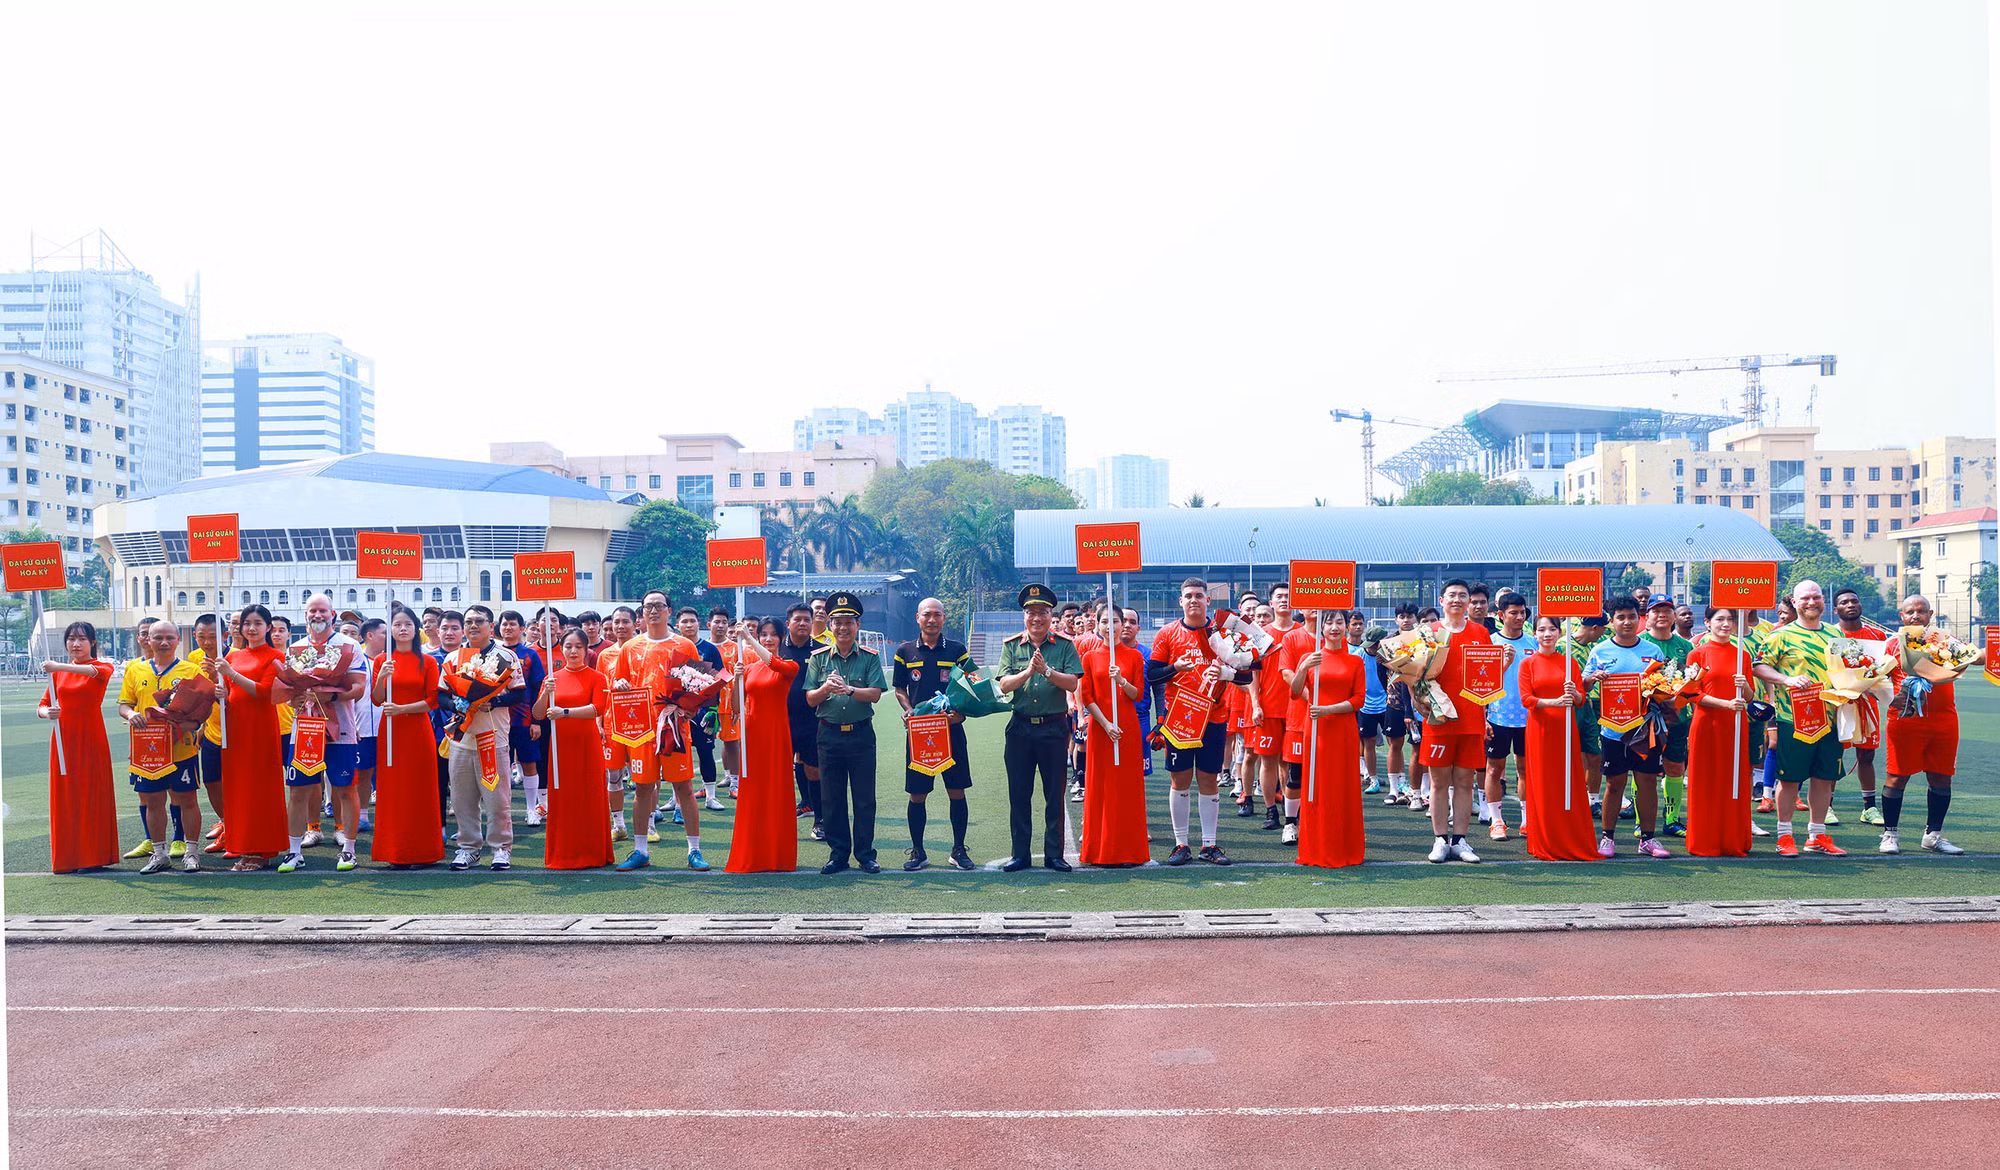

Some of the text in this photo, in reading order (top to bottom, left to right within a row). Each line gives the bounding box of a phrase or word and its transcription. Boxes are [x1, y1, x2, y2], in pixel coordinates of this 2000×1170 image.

[193, 528, 234, 540] ĐẠI SỨ QUÁN
[207, 540, 221, 548] ANH
[1082, 537, 1134, 549] ĐẠI SỨ QUÁN
[363, 546, 416, 556] ĐẠI SỨ QUÁN
[1097, 550, 1120, 558] CUBA
[8, 556, 57, 569] ĐẠI SỨ QUÁN
[382, 557, 399, 565] LÀO
[711, 556, 762, 569] TỔ TRỌNG TÀI
[521, 566, 568, 577] BỘ CÔNG AN
[528, 576, 562, 587] VIỆT NAM
[1296, 575, 1349, 586] ĐẠI SỨ QUÁN
[1718, 576, 1770, 586] ĐẠI SỨ QUÁN
[1295, 585, 1349, 595] TRUNG QUỐC
[1545, 583, 1596, 594] ĐẠI SỨ QUÁN
[1737, 586, 1750, 594] ÚC
[1545, 594, 1595, 602] CAMPUCHIA
[1259, 735, 1273, 748] 27
[1291, 741, 1302, 755] 10
[1429, 743, 1446, 759] 77
[1170, 752, 1177, 766] 7
[631, 759, 643, 774] 88
[181, 769, 191, 784] 4
[286, 765, 296, 782] 10
